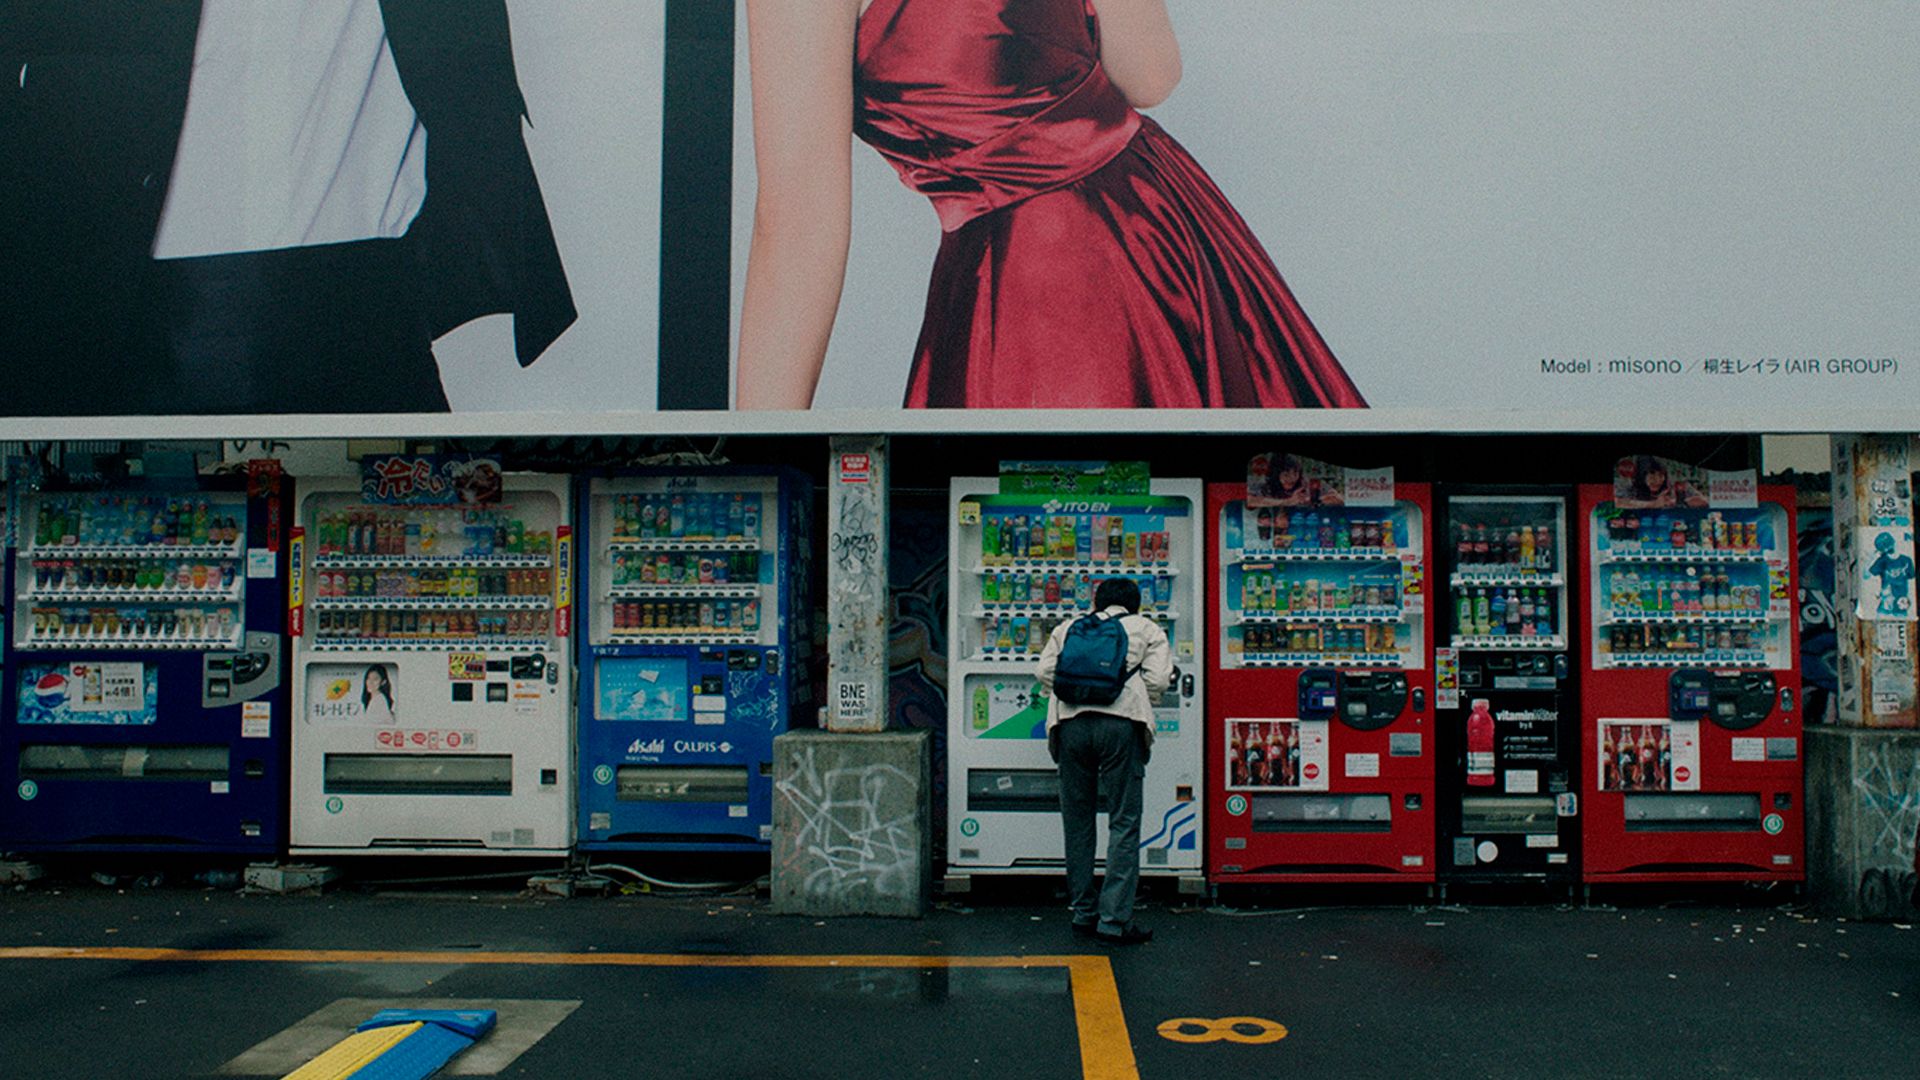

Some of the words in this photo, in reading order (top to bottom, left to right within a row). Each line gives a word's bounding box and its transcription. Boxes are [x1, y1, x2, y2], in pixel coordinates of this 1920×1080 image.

[1541, 359, 1591, 374] Model
[1609, 356, 1682, 374] misono
[1704, 358, 1780, 375] 桐生レイラ
[1827, 358, 1899, 376] GROUP)
[373, 456, 444, 498] 冷たい
[1062, 501, 1089, 513] ITO
[1090, 501, 1112, 513] EN
[1877, 496, 1896, 508] JS
[840, 684, 865, 699] BNE
[840, 700, 866, 708] WAS
[840, 709, 864, 717] HERE
[628, 738, 665, 754] Asahi
[673, 739, 717, 754] CALPIS
[1155, 1015, 1289, 1045] 8
